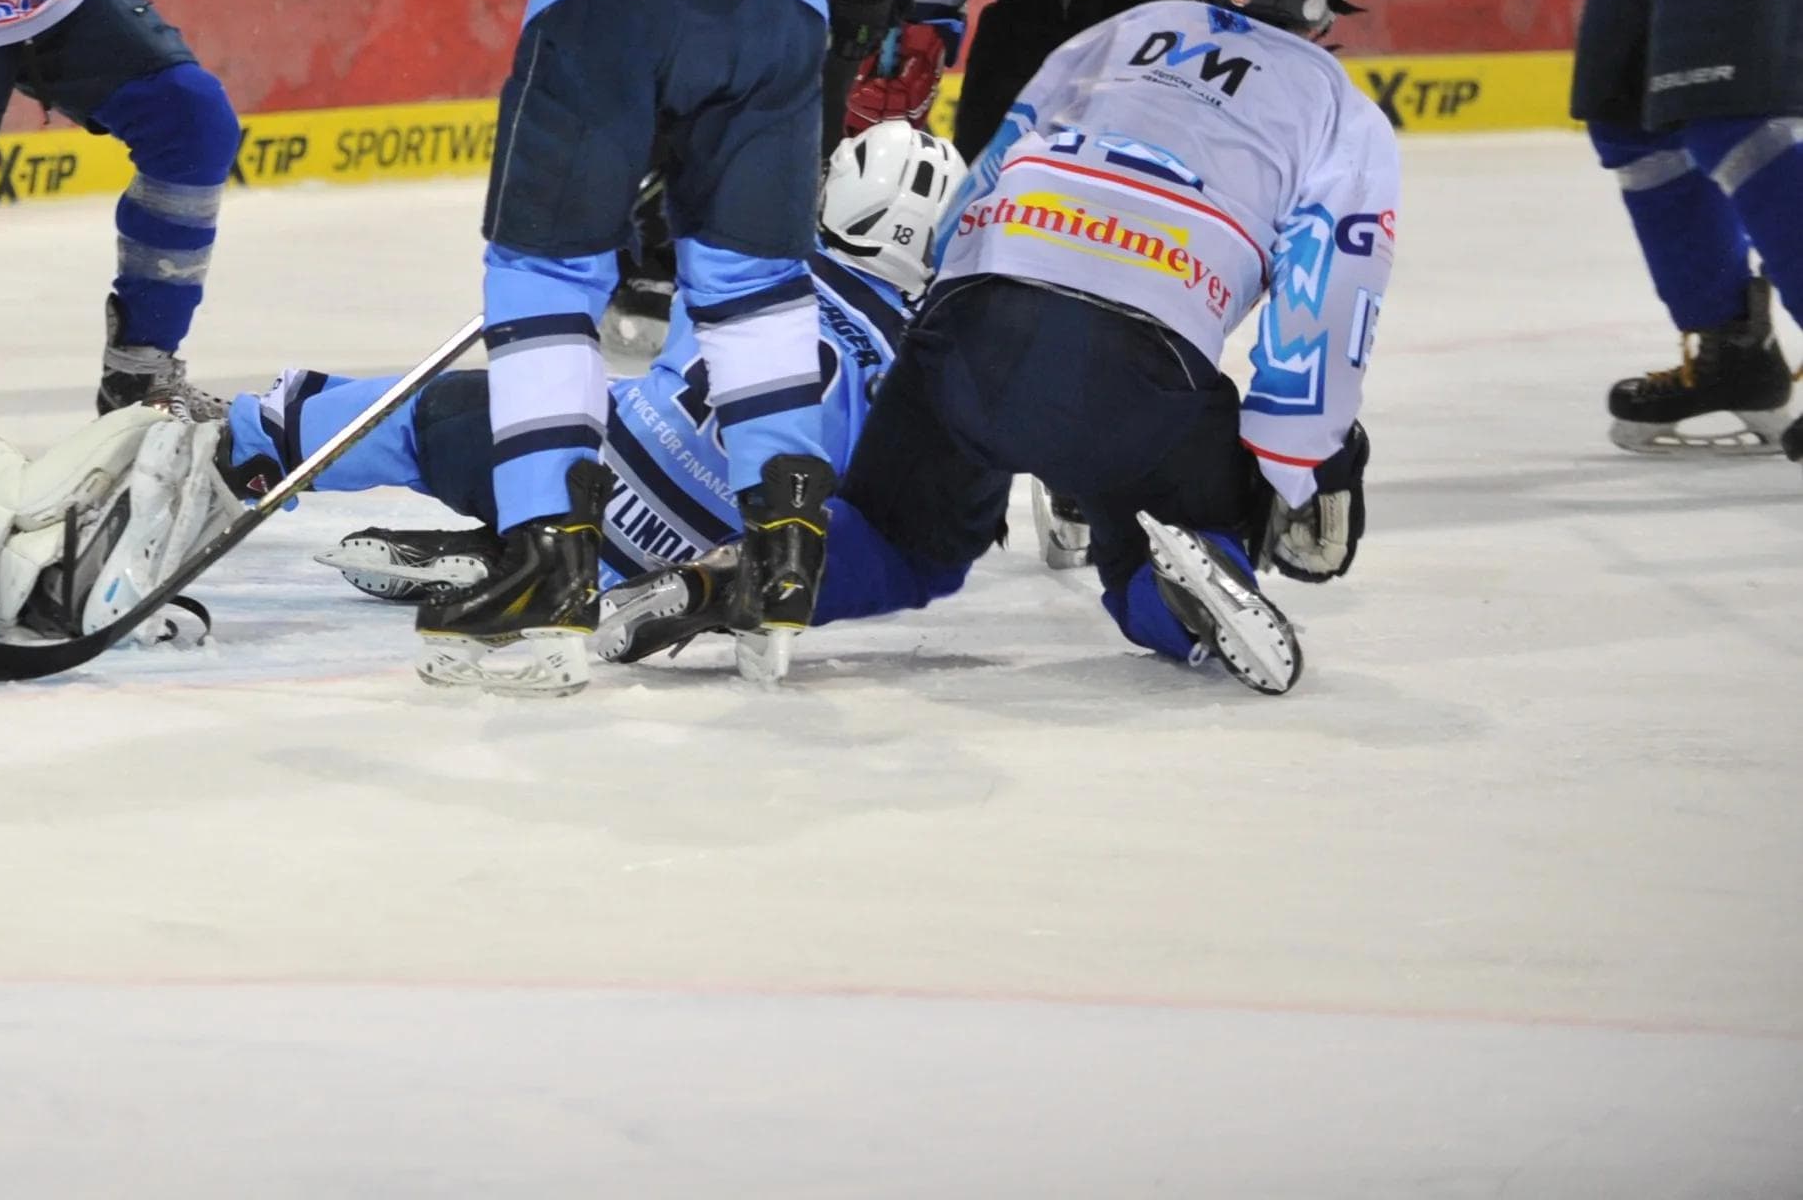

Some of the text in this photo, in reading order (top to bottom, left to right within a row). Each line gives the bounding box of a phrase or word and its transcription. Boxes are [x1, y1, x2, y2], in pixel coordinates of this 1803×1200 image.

[1127, 30, 1253, 98] DVM
[892, 224, 914, 246] 18
[956, 197, 1232, 312] Schmidmeyer
